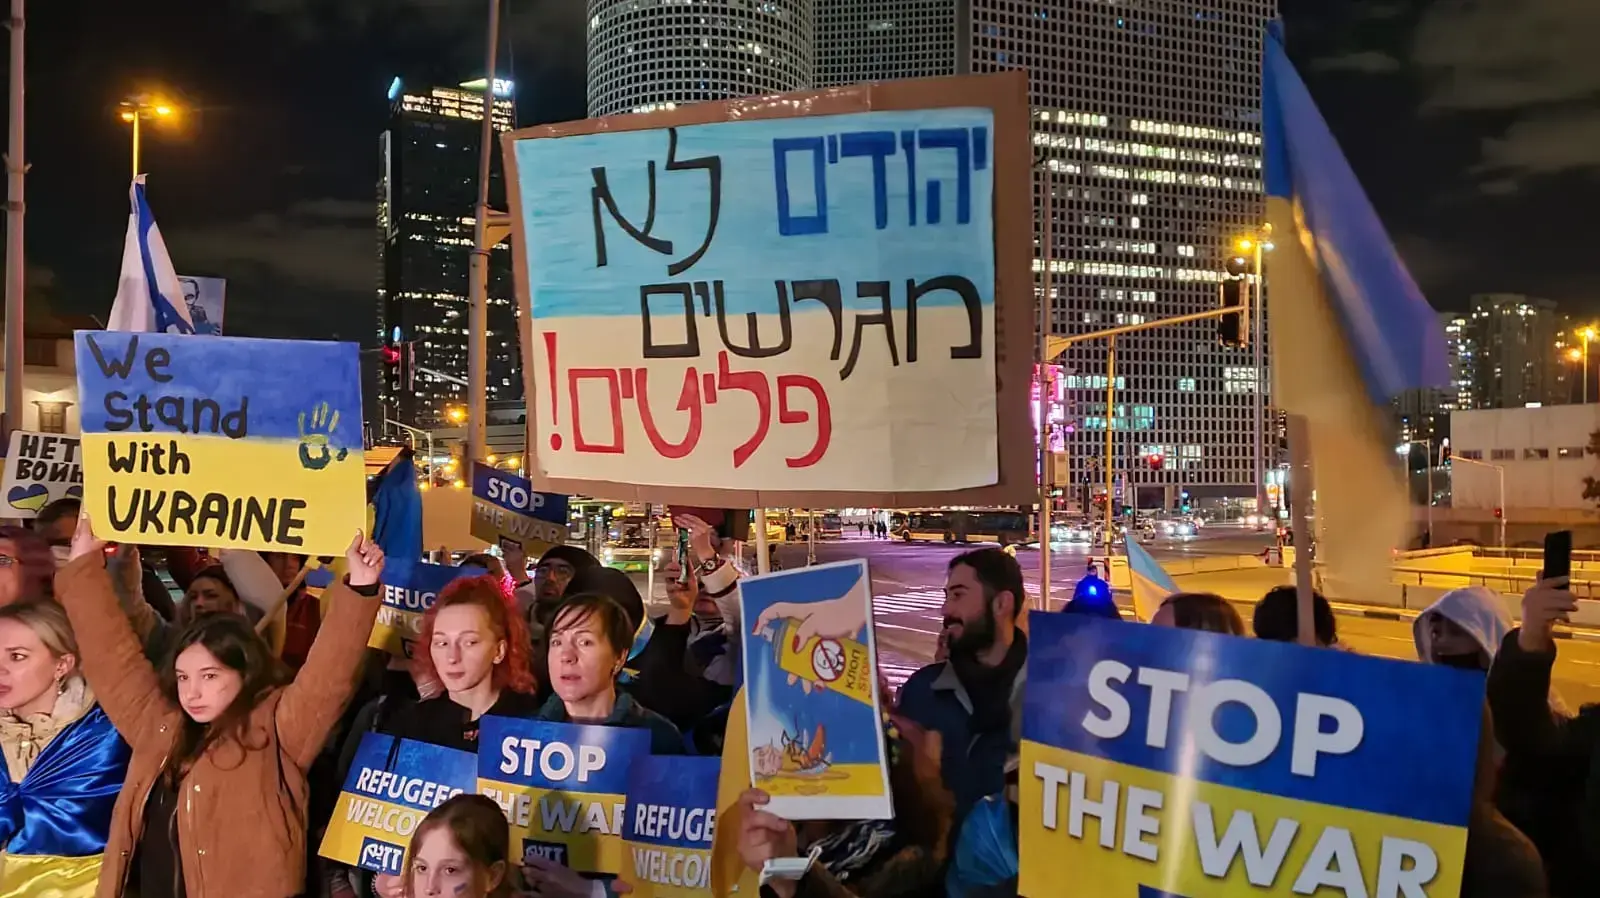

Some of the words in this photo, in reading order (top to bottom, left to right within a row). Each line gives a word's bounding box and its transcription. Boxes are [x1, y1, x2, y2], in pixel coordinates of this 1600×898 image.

[590, 127, 722, 276] לא
[773, 126, 988, 236] יהודים
[640, 274, 984, 381] מגרשים
[86, 334, 174, 384] We
[542, 331, 832, 469] פליטים!
[19, 434, 81, 463] НЕТ
[107, 440, 191, 476] With
[107, 486, 307, 547] UKRAINE
[487, 477, 545, 512] STOP
[475, 502, 504, 529] THE
[508, 515, 560, 544] WAR
[381, 584, 437, 610] EFUG
[1081, 659, 1364, 778] STOP
[500, 735, 606, 782] STOP
[346, 797, 425, 837] WELCO
[482, 787, 532, 828] THE
[634, 803, 716, 842] REFUGE
[1034, 761, 1164, 862] THE
[1192, 802, 1440, 898] WAR
